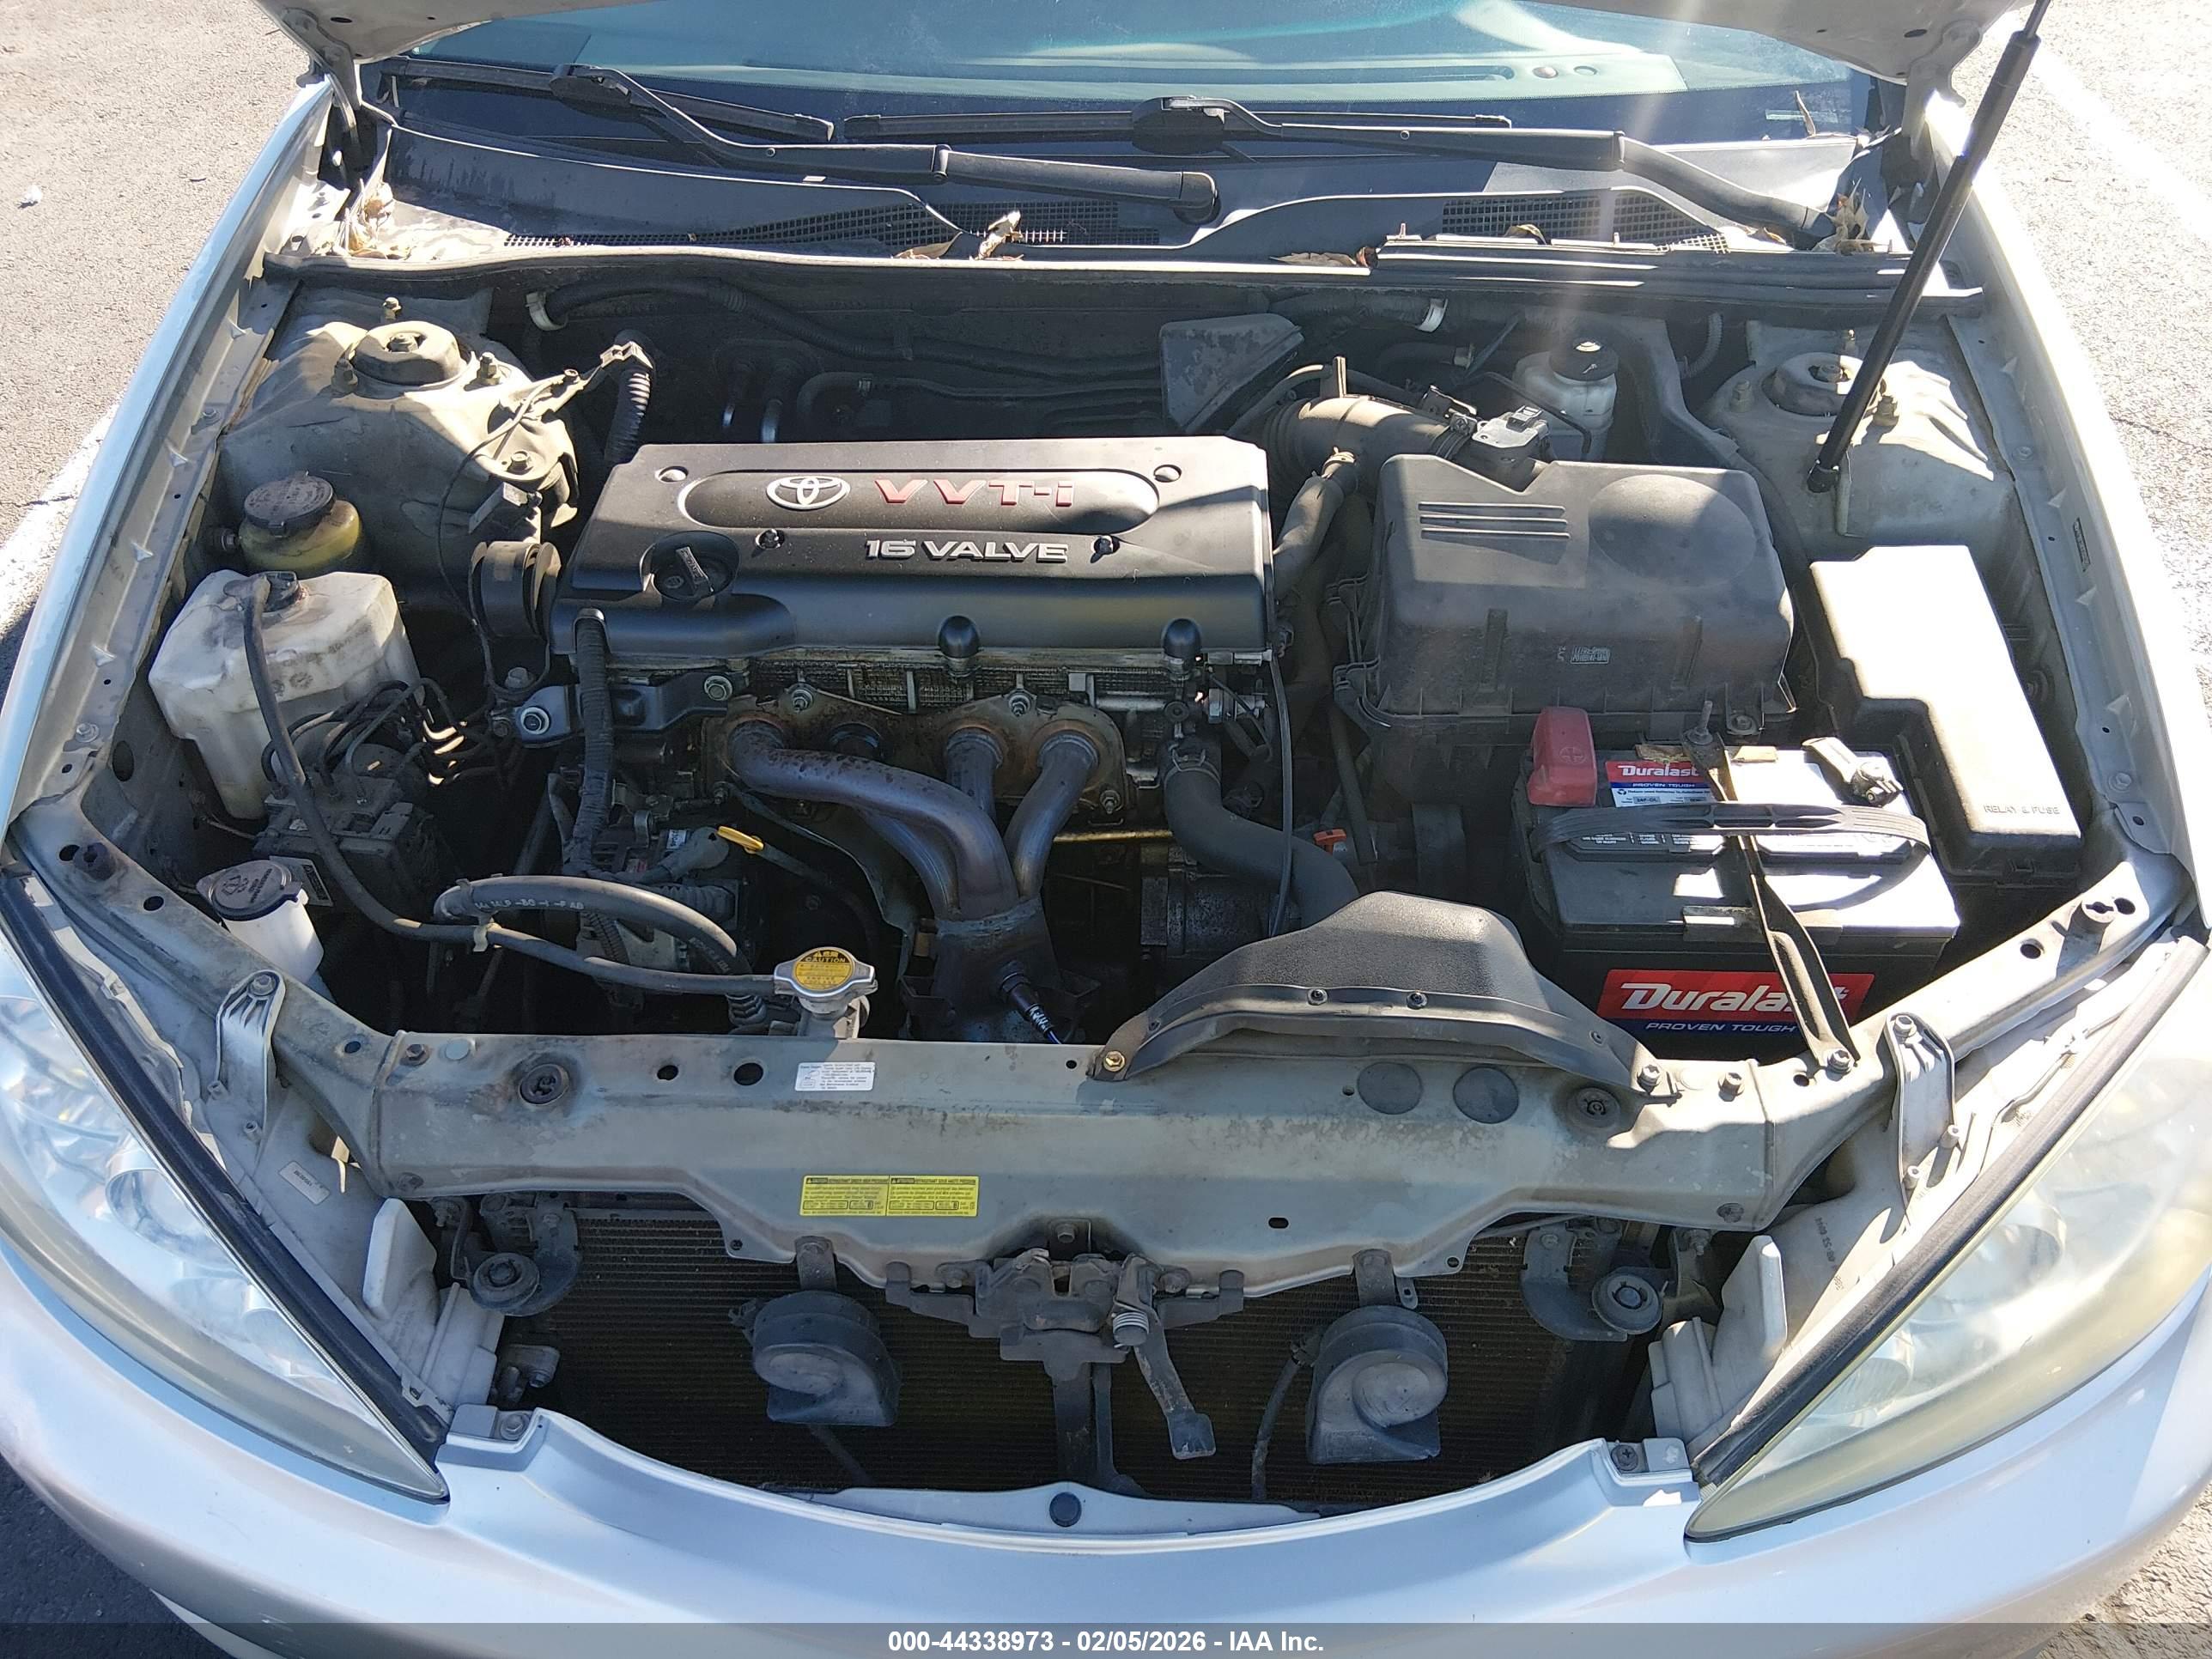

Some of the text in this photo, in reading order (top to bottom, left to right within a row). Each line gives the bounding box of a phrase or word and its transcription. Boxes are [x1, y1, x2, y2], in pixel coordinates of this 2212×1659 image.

[866, 539, 1069, 563] 16 VALVE
[1617, 763, 1699, 776] Duralast
[1984, 805, 2017, 814] RELAY
[2032, 806, 2061, 815] FUSE
[1620, 982, 1849, 1012] Duralat
[1645, 1022, 1797, 1033] PROVEN TOUGH
